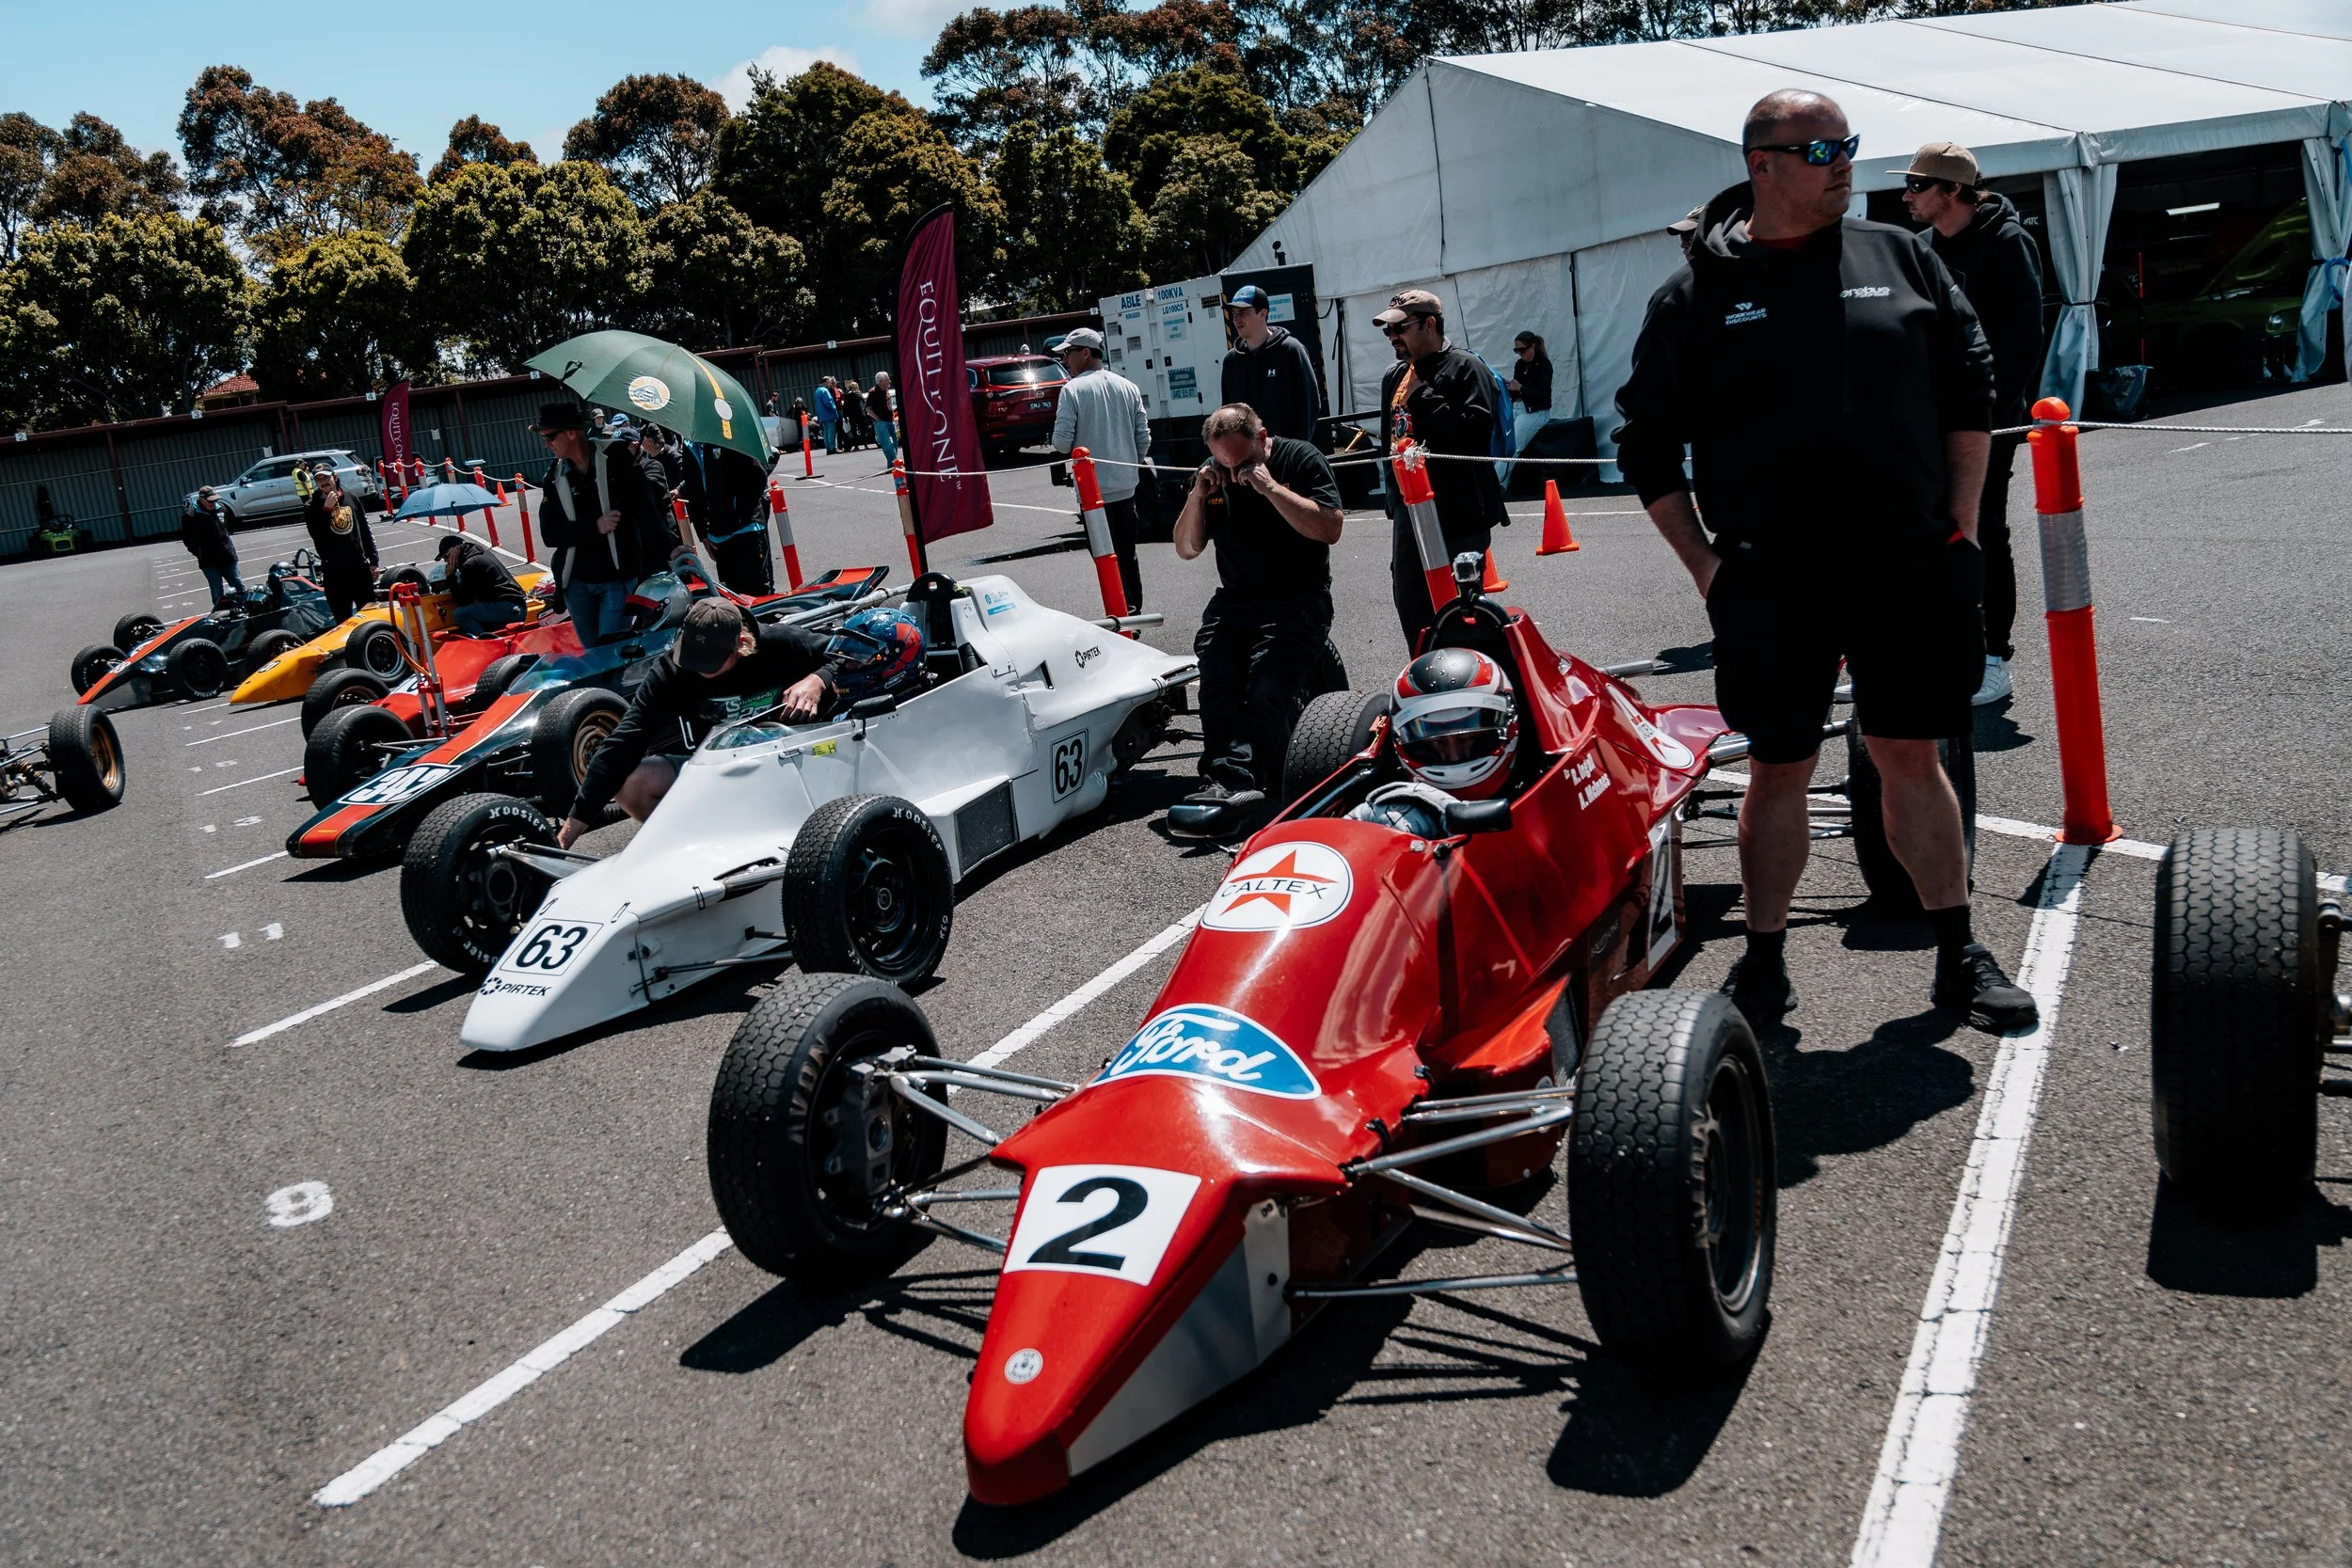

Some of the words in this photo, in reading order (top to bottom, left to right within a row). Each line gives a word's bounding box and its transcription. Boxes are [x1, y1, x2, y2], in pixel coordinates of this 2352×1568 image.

[1120, 293, 1141, 309] ABLE
[1157, 287, 1184, 301] 100KVA
[1724, 308, 1767, 321] WORKWEAR
[1724, 313, 1768, 325] DISCOUNTS
[1083, 645, 1101, 661] PIRTEK
[827, 743, 837, 754] H
[1055, 738, 1083, 795] 63
[348, 767, 451, 802] 342
[488, 806, 547, 832] Hoosier
[892, 807, 943, 851] Hoosier
[1221, 879, 1327, 900] CALTEX
[516, 924, 588, 970] 63
[499, 982, 552, 997] PIRTEK
[1110, 1012, 1278, 1082] Ford
[1026, 1176, 1150, 1272] 2
